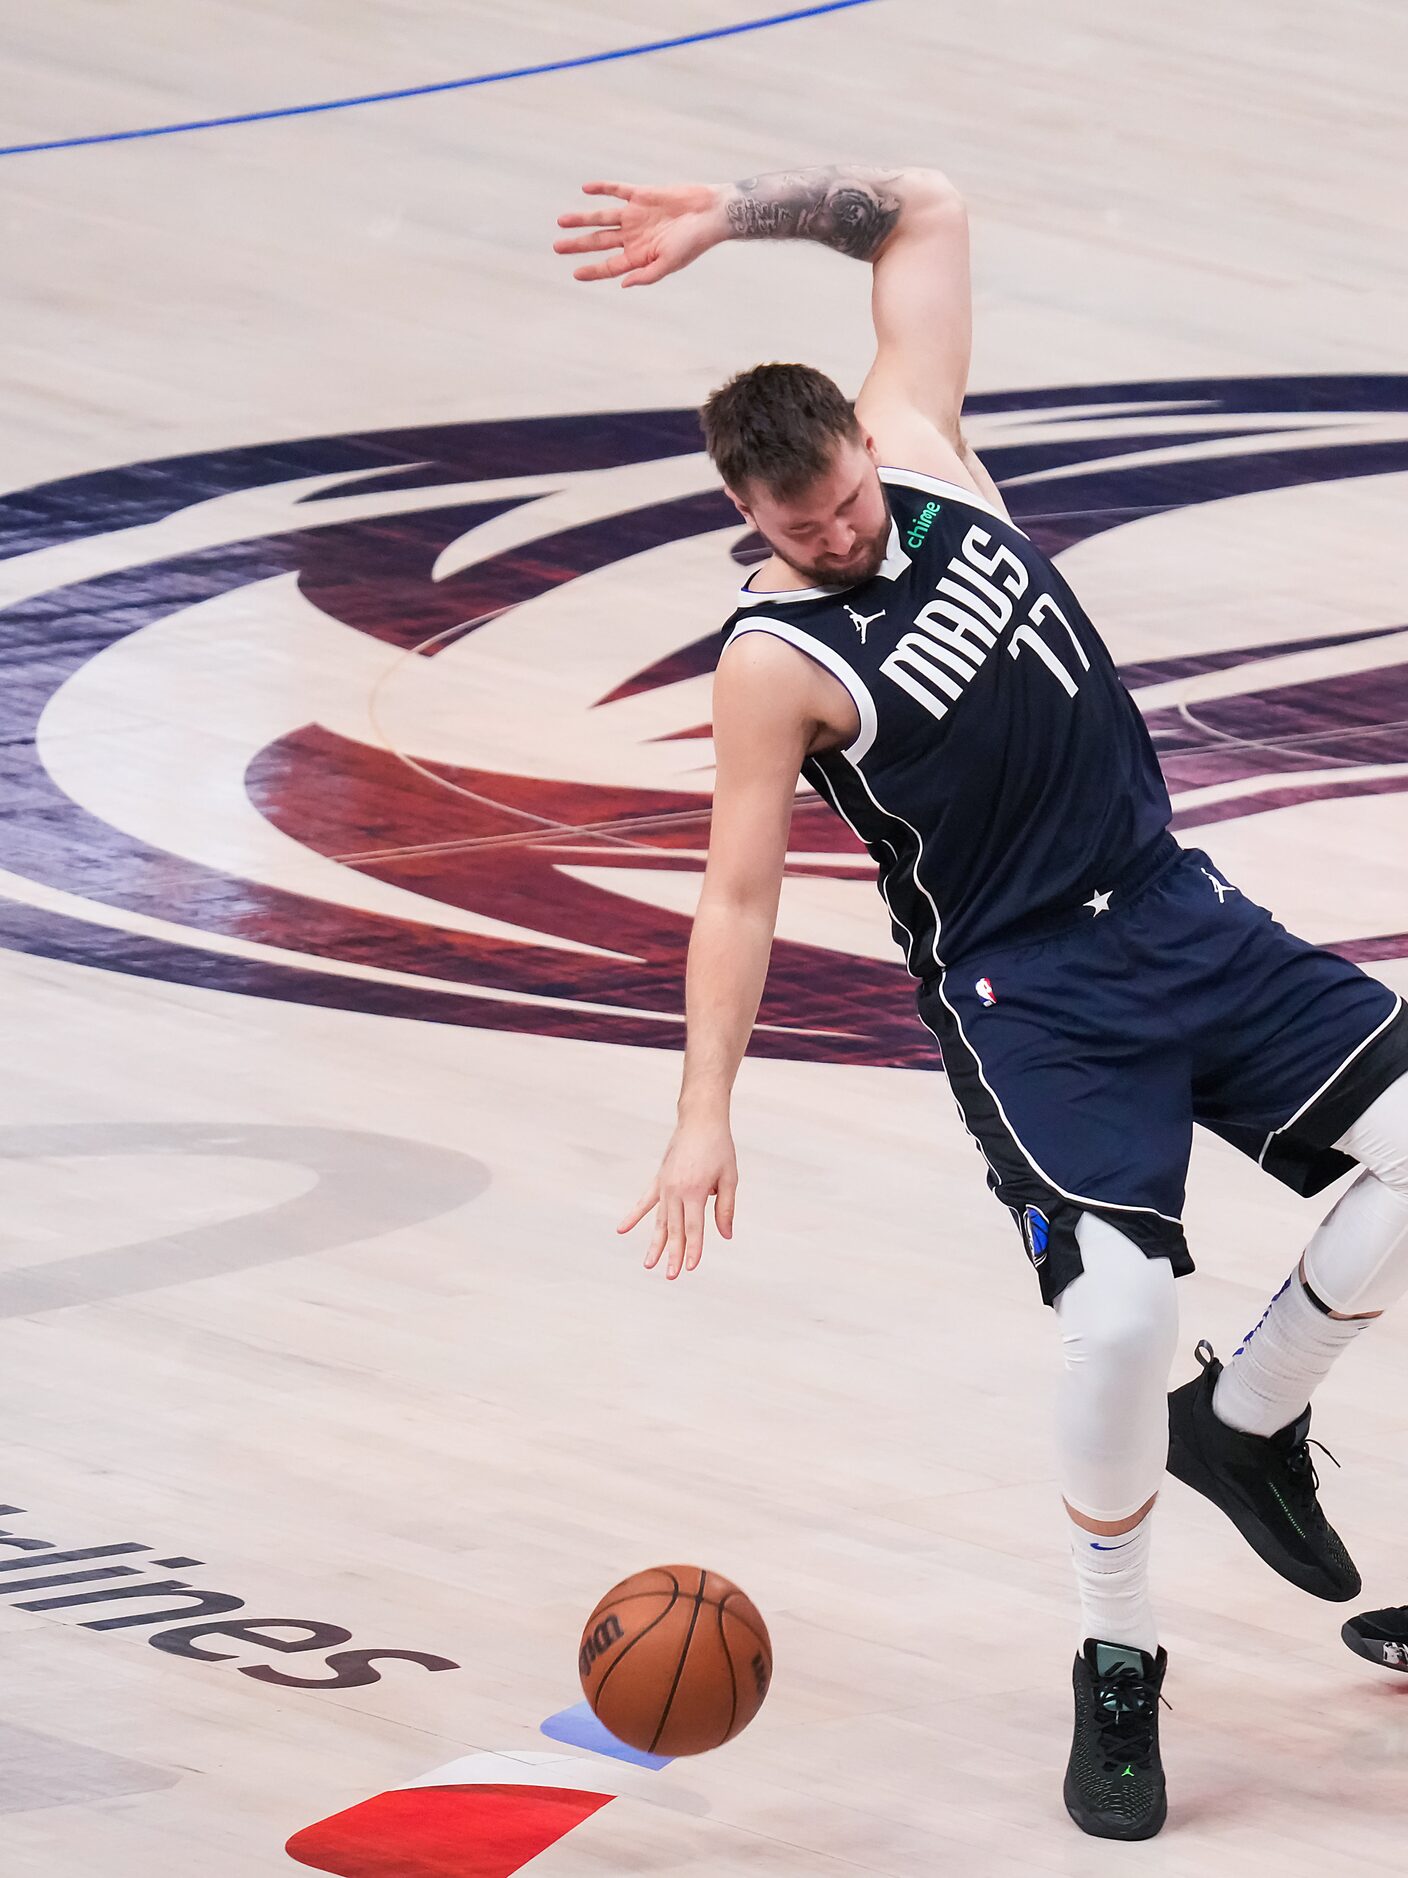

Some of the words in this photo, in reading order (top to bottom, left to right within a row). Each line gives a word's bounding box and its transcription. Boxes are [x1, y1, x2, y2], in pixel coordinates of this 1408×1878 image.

[906, 501, 941, 549] chime
[878, 524, 1029, 720] MAVS
[1007, 592, 1091, 698] 77
